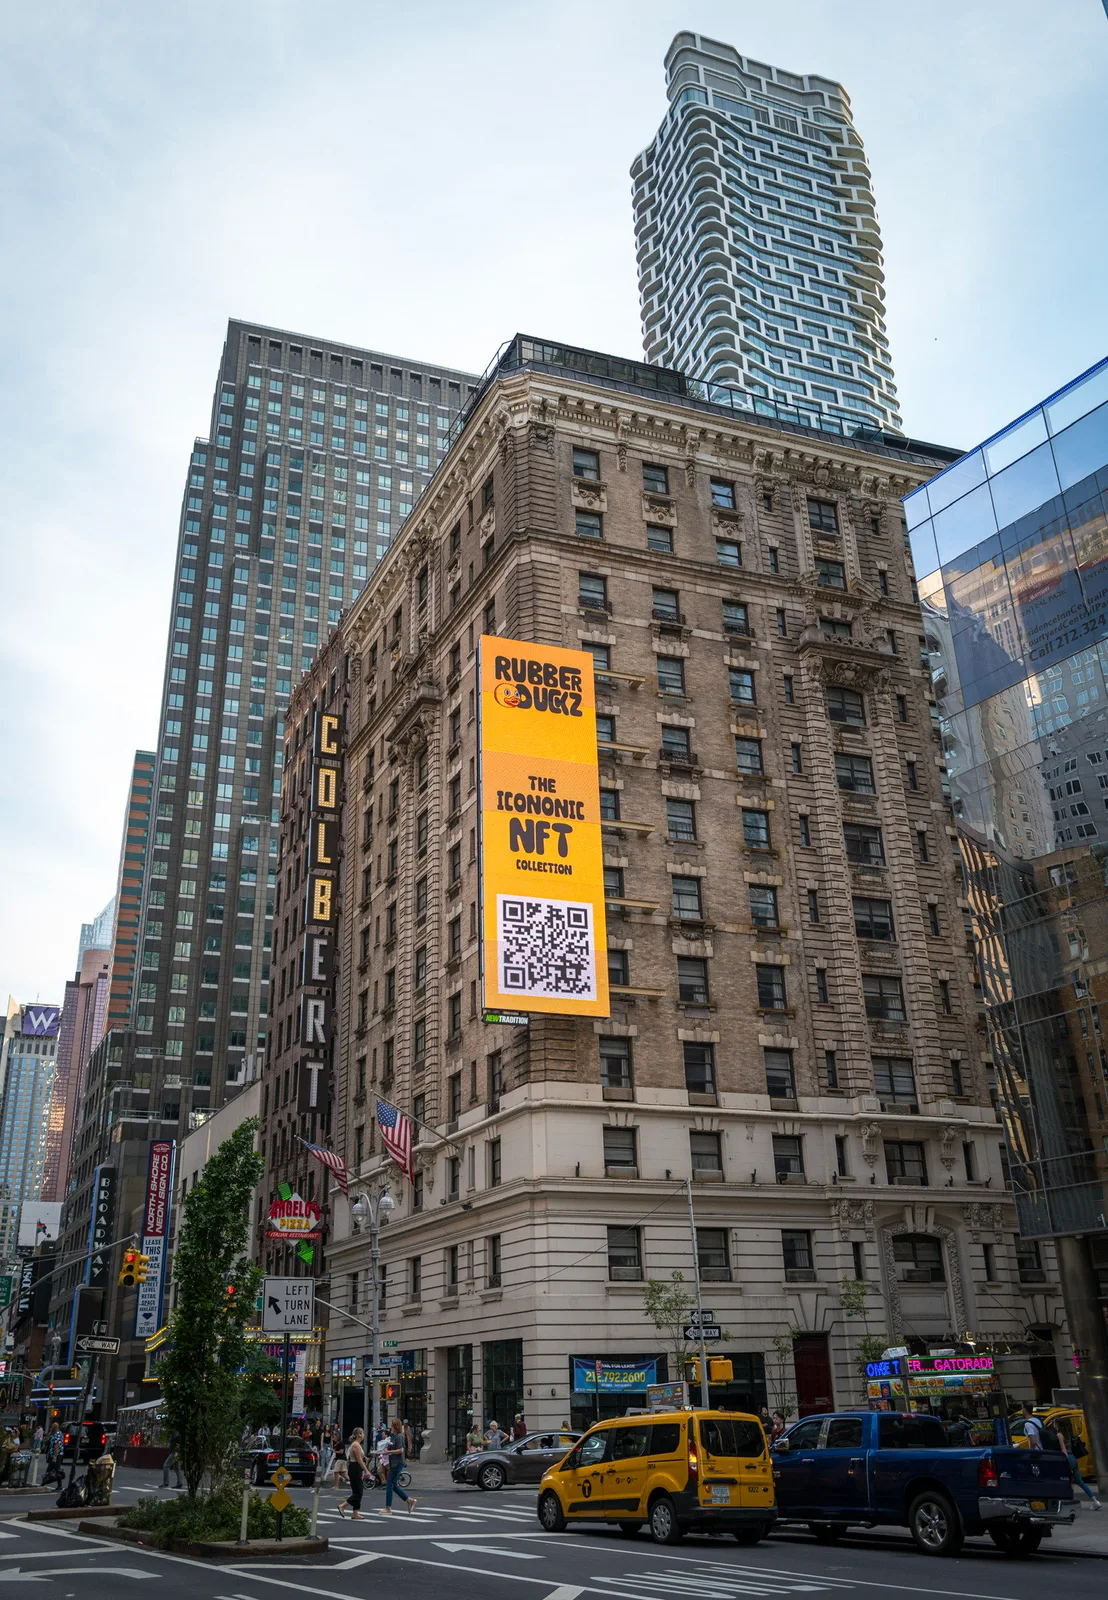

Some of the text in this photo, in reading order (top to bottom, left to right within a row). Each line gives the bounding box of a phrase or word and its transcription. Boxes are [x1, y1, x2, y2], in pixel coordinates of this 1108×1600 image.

[1028, 641, 1054, 662] Call
[495, 655, 582, 692] RUBBER
[515, 684, 583, 717] DUCKZ
[528, 775, 557, 793] THE
[496, 790, 585, 820] ICONONIC
[509, 817, 574, 858] NFT
[516, 859, 572, 875] COLLECTION
[306, 715, 338, 1108] COLBERT
[29, 1010, 56, 1031] W
[146, 1153, 160, 1233] NORTH SHORE
[158, 1173, 167, 1202] SIGN
[92, 1177, 111, 1278] BROADWAY
[155, 1202, 165, 1234] NEON
[279, 1218, 311, 1230] PIZZA
[145, 1246, 161, 1255] THIS
[285, 1285, 309, 1296] LEFT
[285, 1299, 310, 1311] TURN
[284, 1314, 309, 1325] LANE
[81, 1340, 115, 1349] ONE WAY
